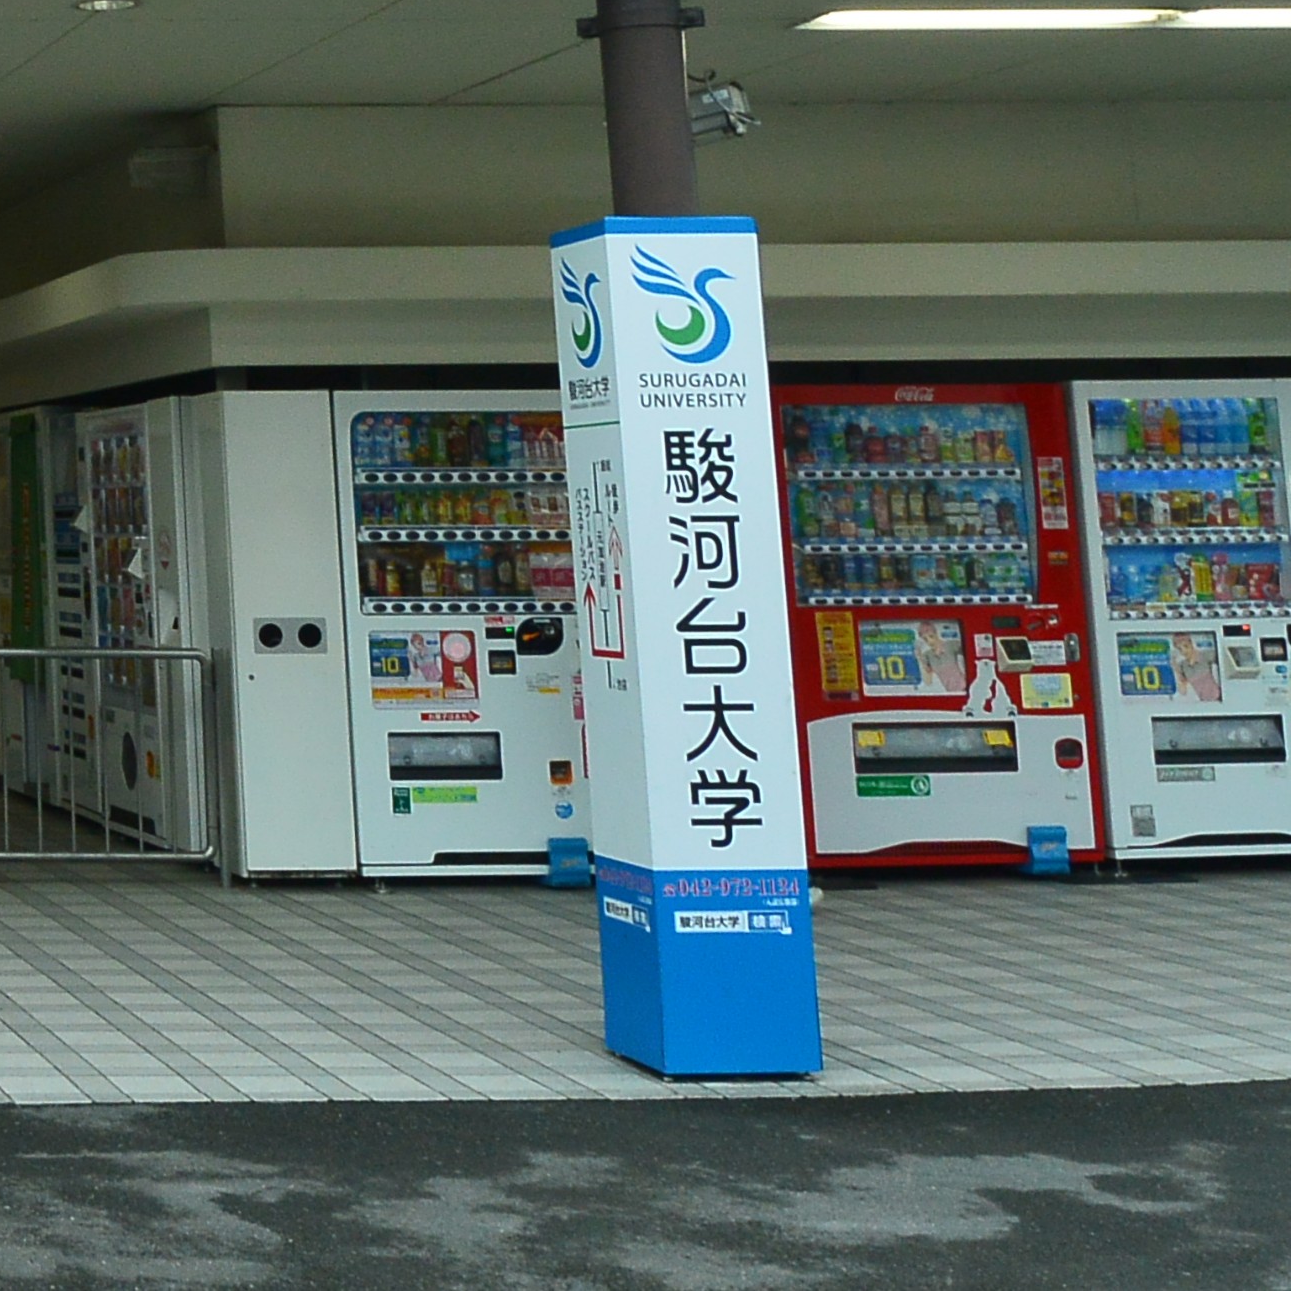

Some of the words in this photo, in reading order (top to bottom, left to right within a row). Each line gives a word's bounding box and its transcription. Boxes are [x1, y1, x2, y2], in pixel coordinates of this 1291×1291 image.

[639, 373, 747, 388] SURUGADAI
[640, 393, 747, 408] UNIVERSITY
[663, 427, 763, 848] 駿河台大学
[381, 656, 399, 674] 10
[877, 656, 905, 680] 10
[1132, 666, 1161, 690] 10
[677, 877, 800, 897] 042-972-1124
[679, 915, 740, 929] 駿河台大学
